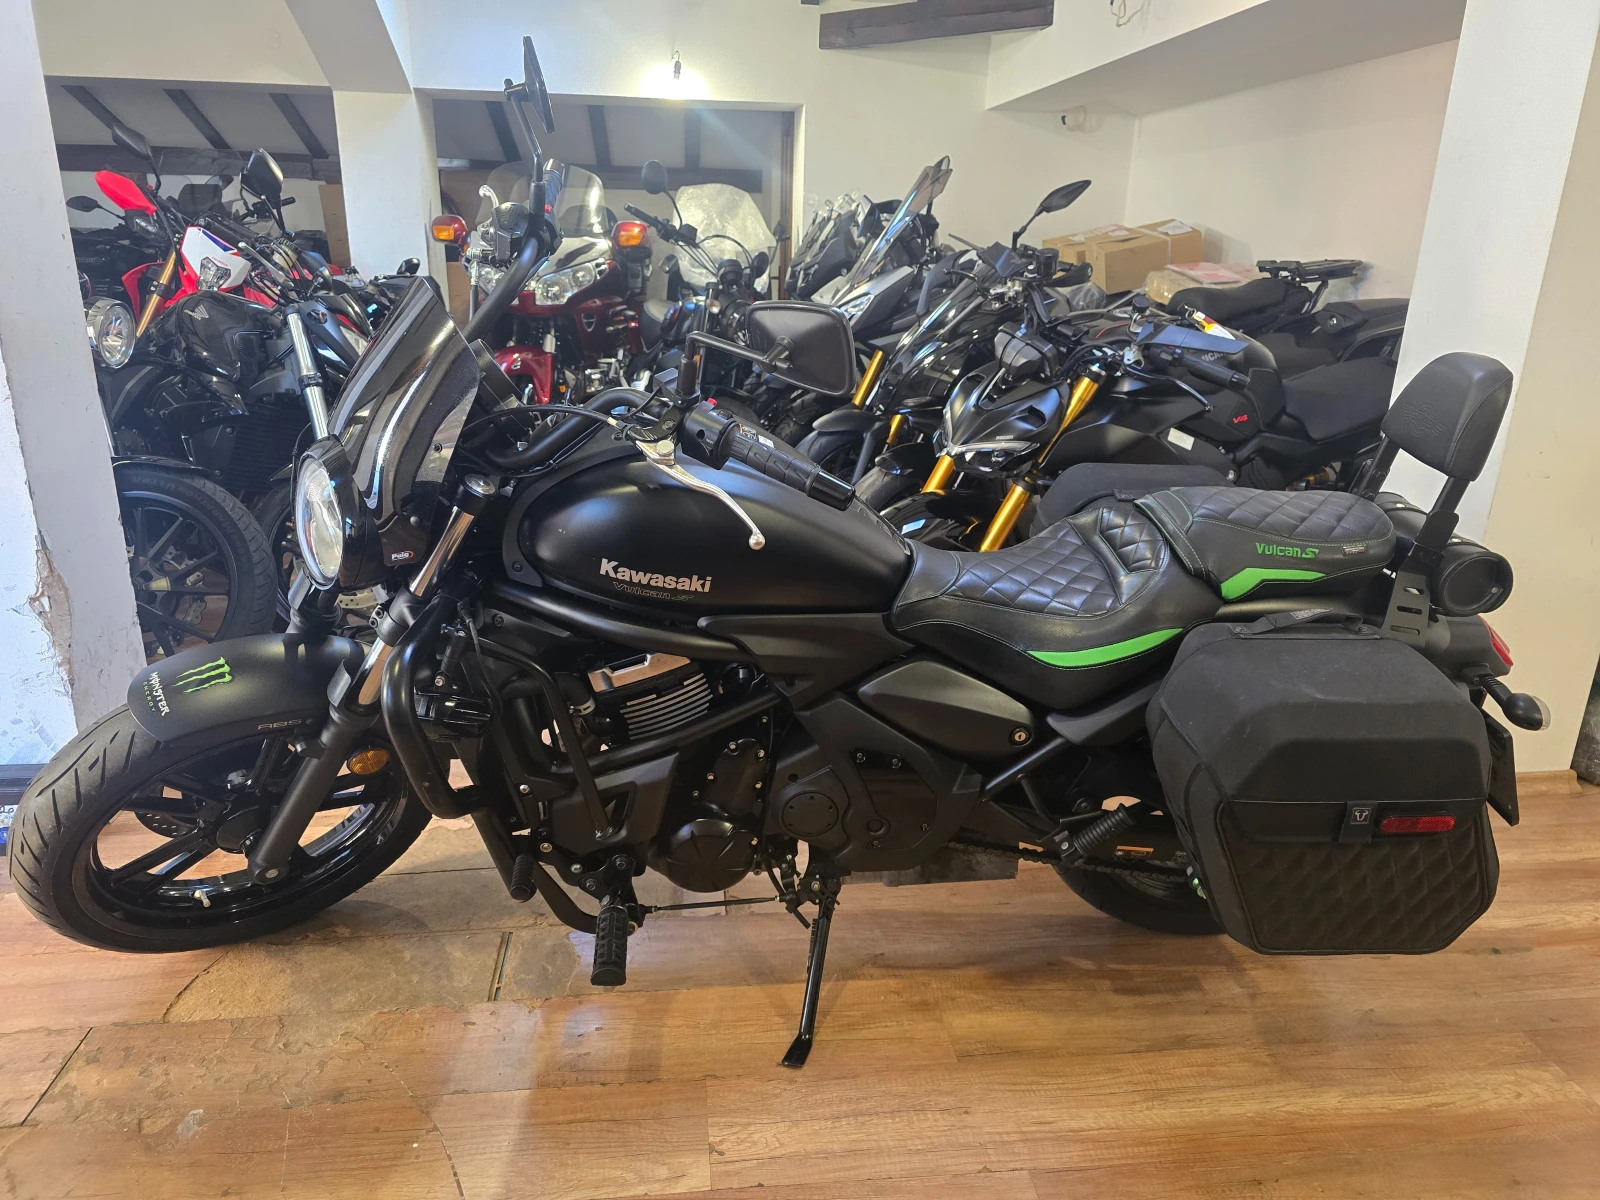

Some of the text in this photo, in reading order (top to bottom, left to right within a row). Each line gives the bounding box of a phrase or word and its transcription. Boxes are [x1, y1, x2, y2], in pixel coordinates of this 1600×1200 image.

[1232, 414, 1248, 424] V4
[1255, 542, 1301, 557] Vulcan
[600, 558, 712, 592] Kawasaki
[613, 581, 671, 599] Vulcan
[142, 681, 156, 712] ENERGY
[149, 671, 170, 717] MONSTER
[257, 718, 302, 731] ABS
